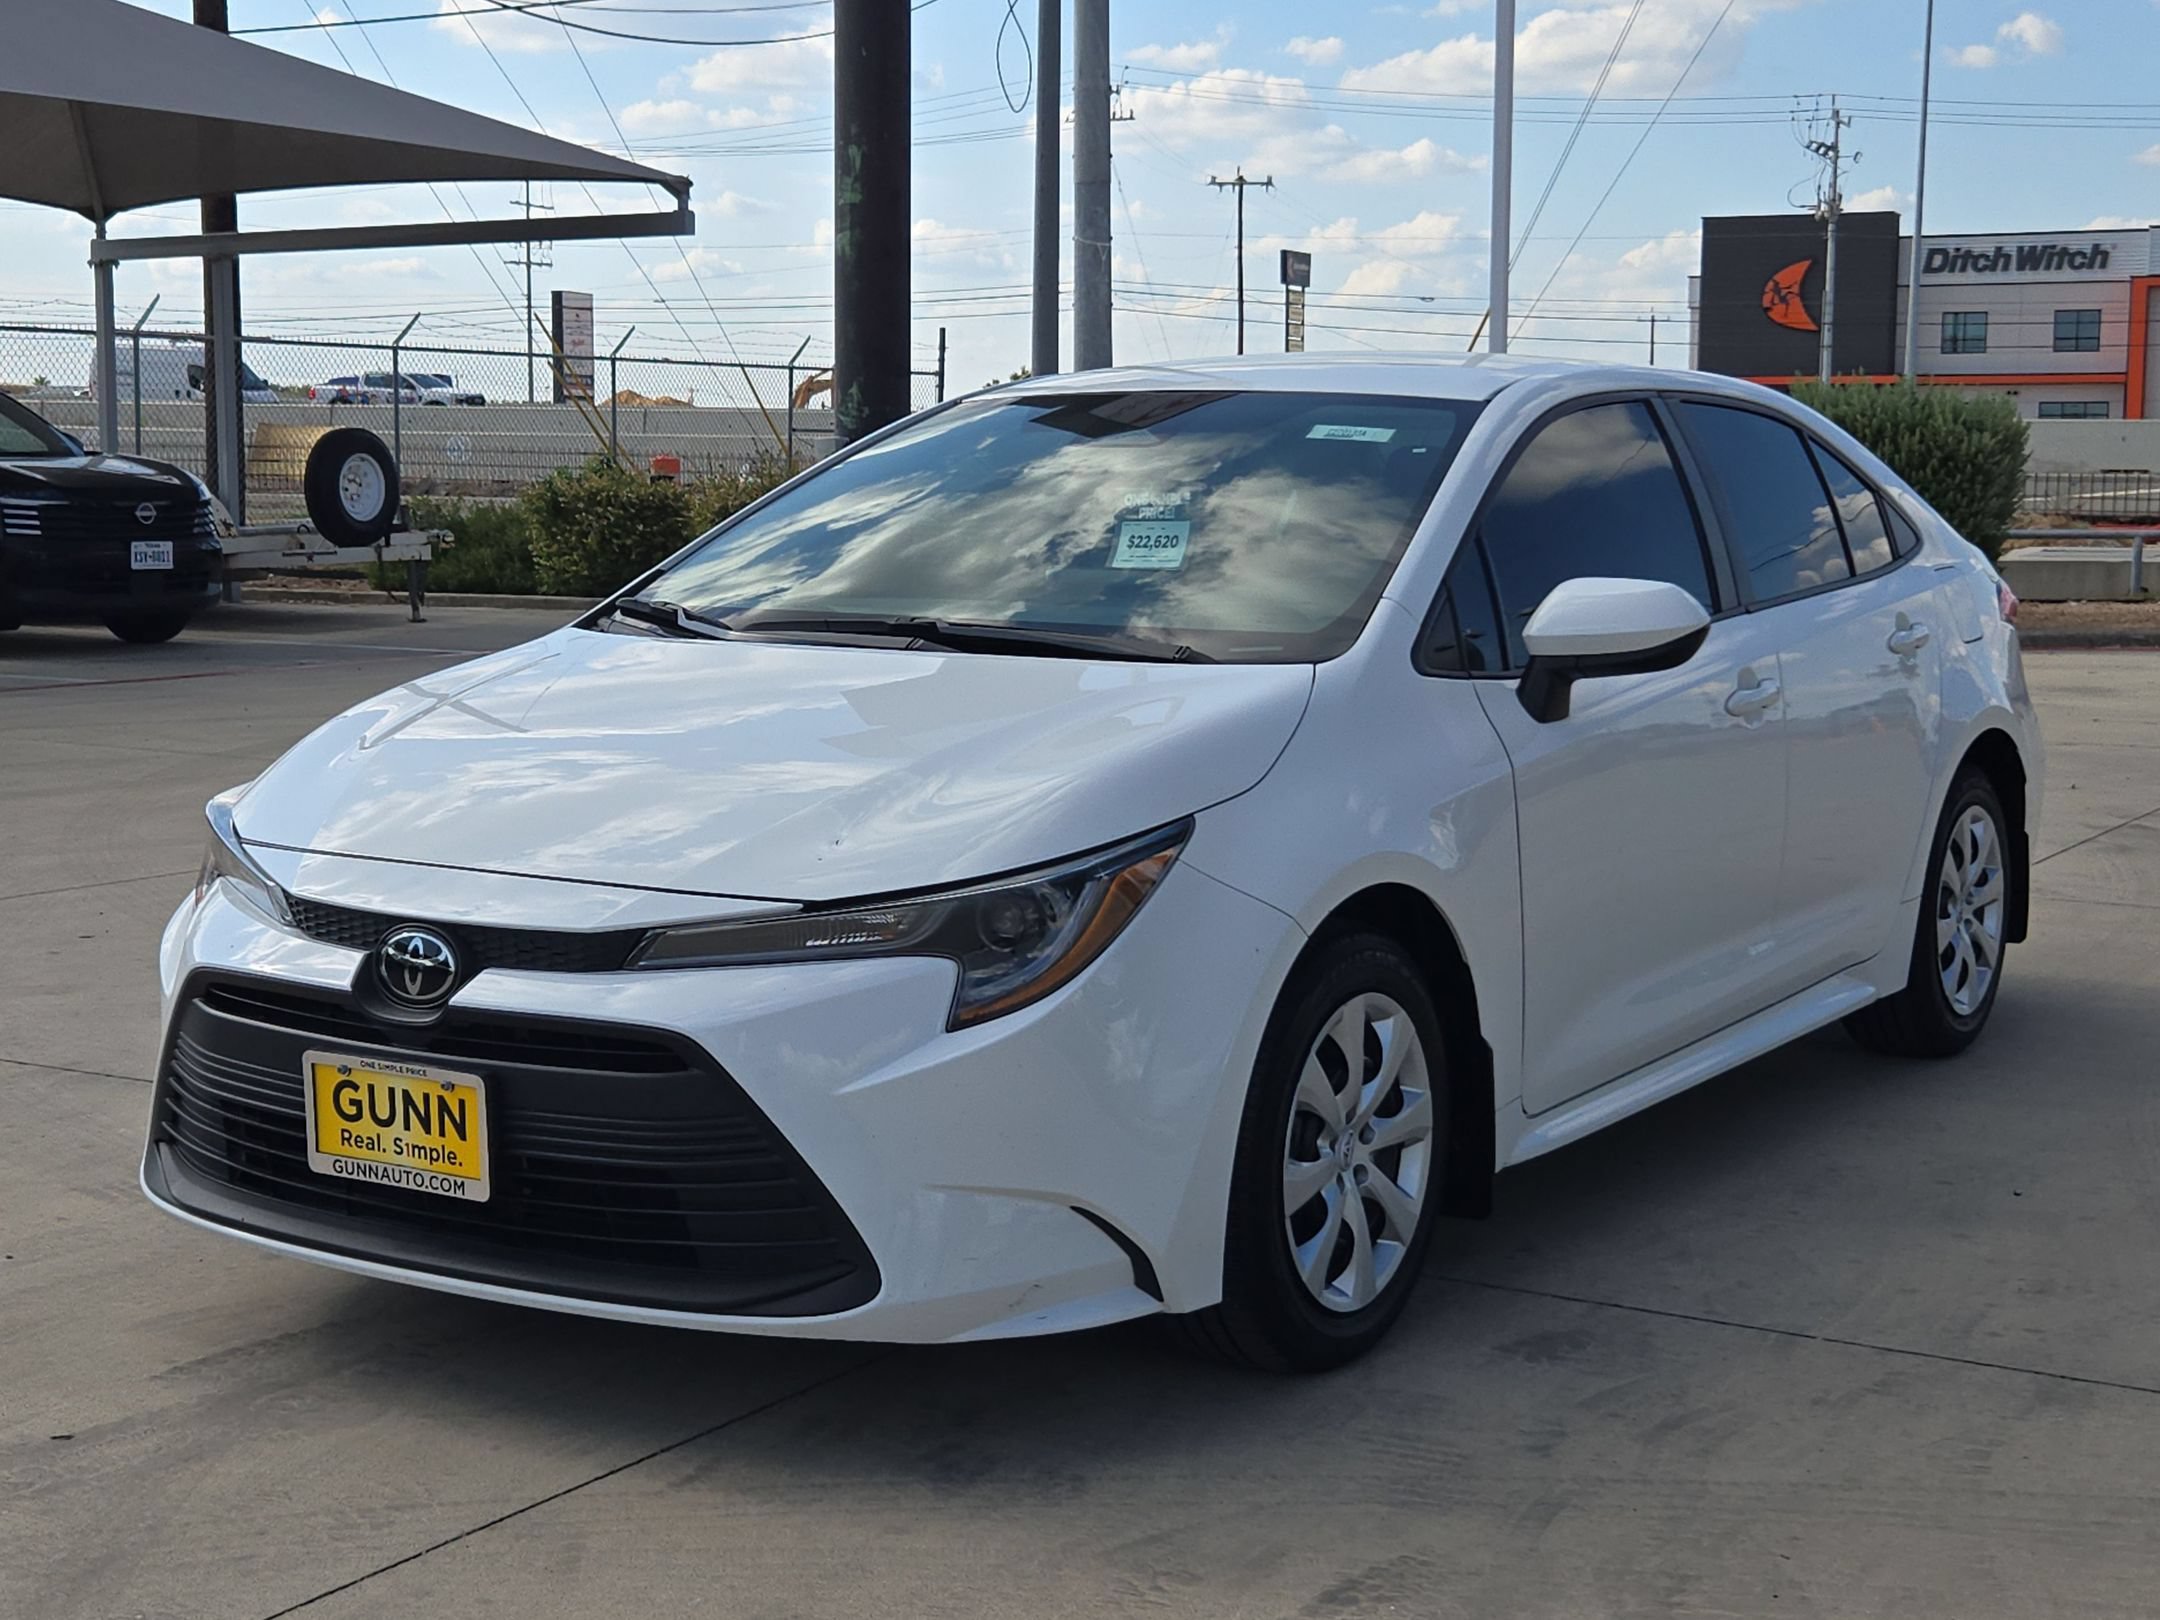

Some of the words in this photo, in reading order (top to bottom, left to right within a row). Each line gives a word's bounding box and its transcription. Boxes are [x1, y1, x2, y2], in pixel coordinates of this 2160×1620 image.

[1922, 245, 2013, 274] Ditch
[2015, 242, 2110, 272] Witch
[1126, 534, 1179, 551] $22,620
[360, 1059, 375, 1070] ONE
[377, 1062, 404, 1074] SIMPLE
[405, 1066, 428, 1077] PRICE
[332, 1079, 467, 1141] GUNN
[340, 1128, 386, 1153] Real.
[332, 1158, 466, 1196] GUNNAUTO.COM
